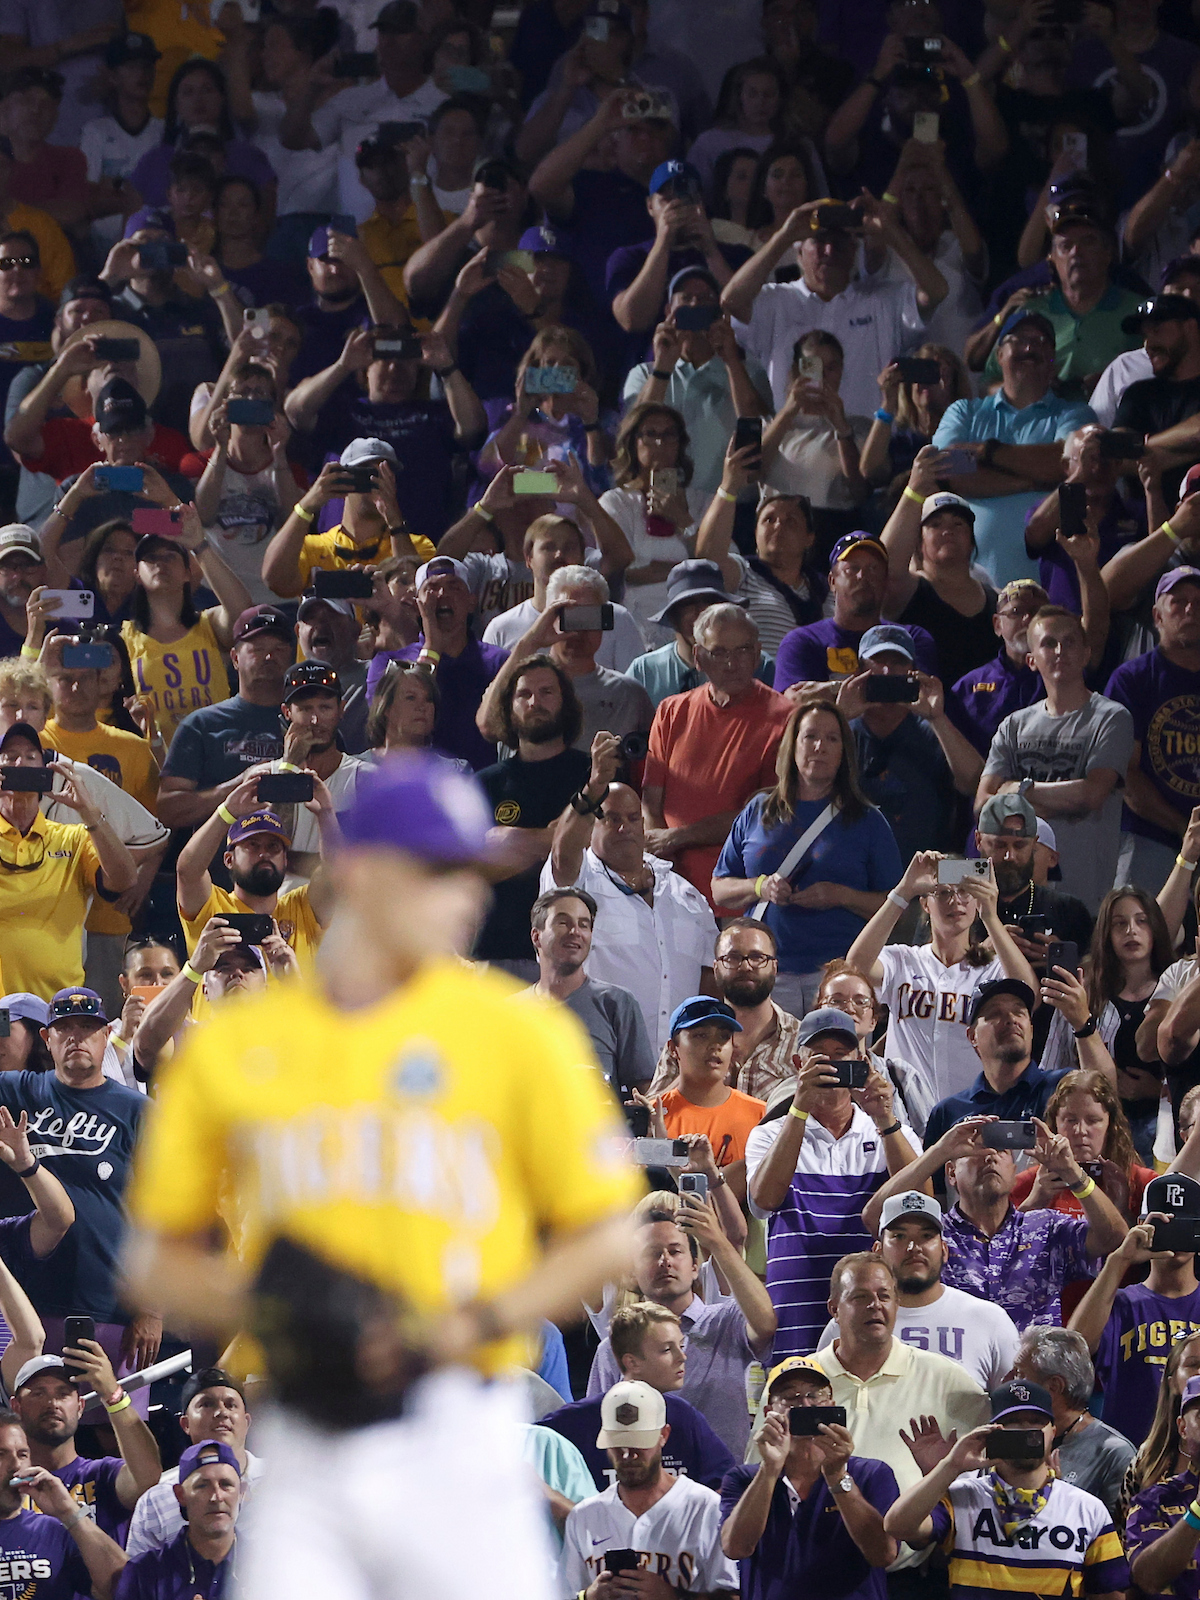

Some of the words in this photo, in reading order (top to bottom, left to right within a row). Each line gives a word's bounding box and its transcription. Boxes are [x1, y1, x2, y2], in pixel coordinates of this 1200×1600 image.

[137, 650, 212, 693] LSU
[153, 690, 213, 712] IGERS
[48, 850, 72, 860] LSU
[25, 1107, 118, 1150] Lefty
[900, 1327, 966, 1363] SU
[973, 1508, 1088, 1552] Atros
